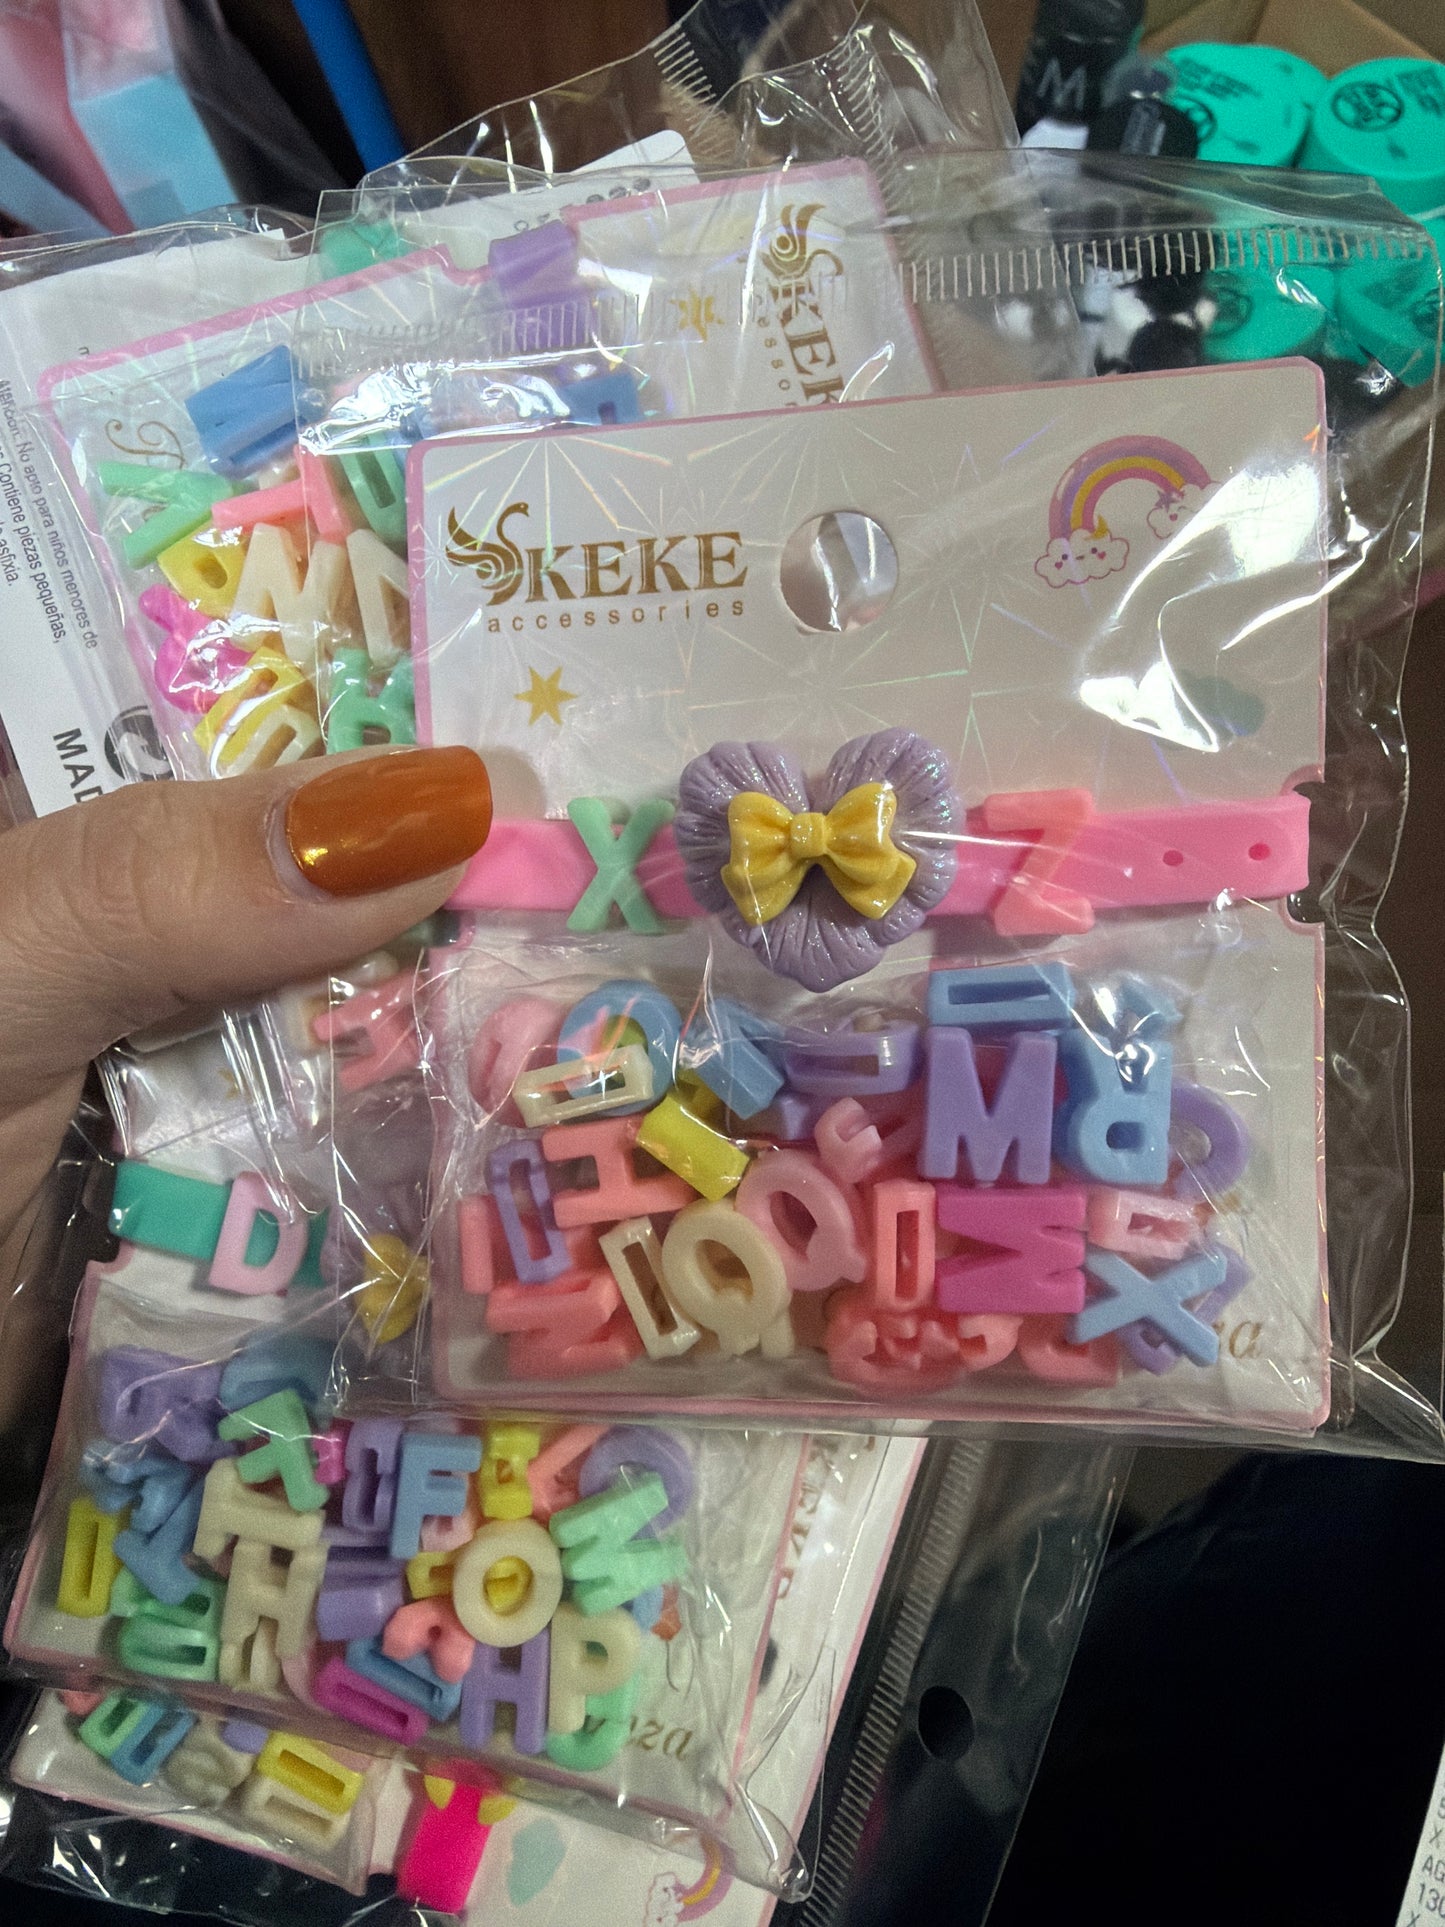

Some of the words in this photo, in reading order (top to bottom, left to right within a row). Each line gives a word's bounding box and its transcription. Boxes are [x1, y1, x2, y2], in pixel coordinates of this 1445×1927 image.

[24, 464, 42, 496] apto
[32, 497, 55, 528] para
[47, 530, 69, 568] niños
[13, 525, 42, 570] piezas
[29, 572, 66, 644] pequeñas,
[60, 569, 90, 629] menores
[487, 601, 744, 633] accessories
[82, 630, 98, 649] de
